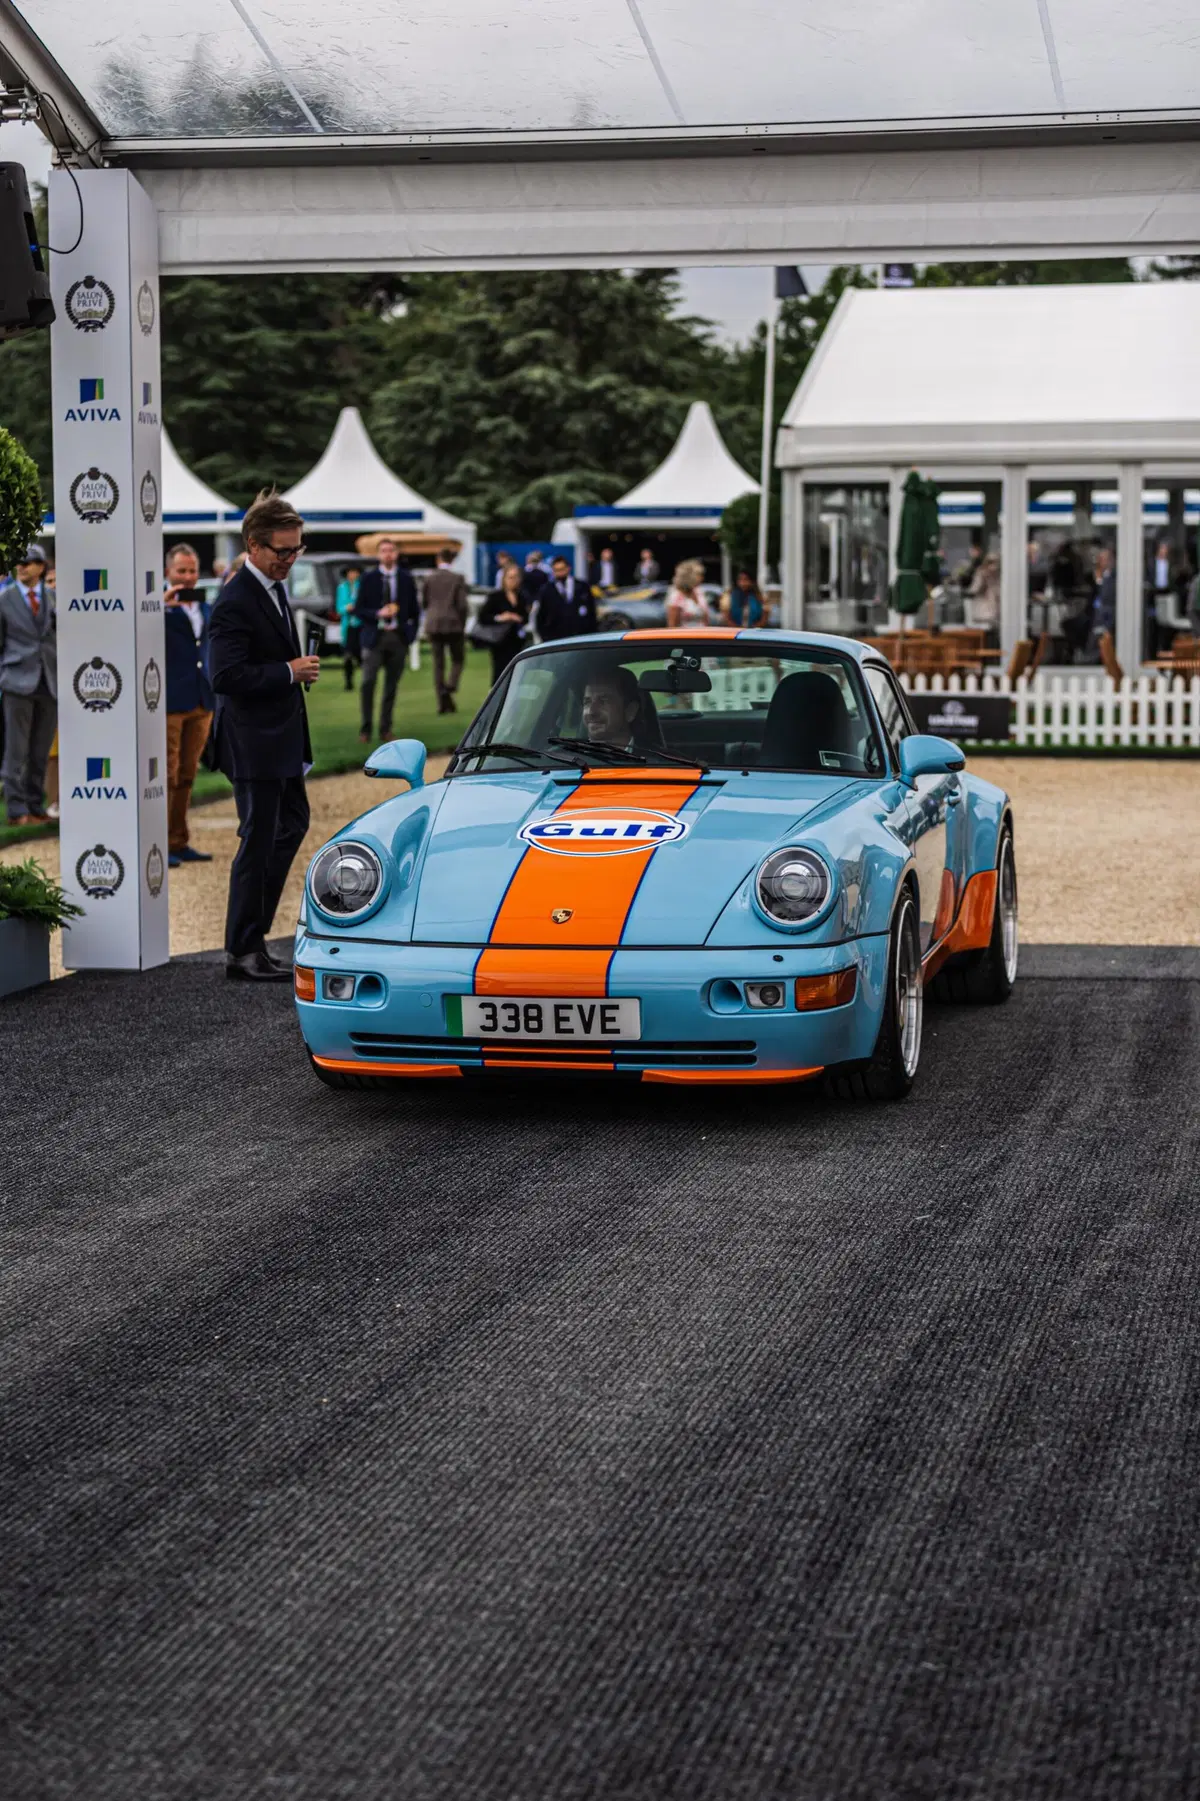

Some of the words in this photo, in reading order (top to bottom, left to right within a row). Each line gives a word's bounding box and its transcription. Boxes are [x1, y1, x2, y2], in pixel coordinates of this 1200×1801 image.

[64, 408, 121, 422] AVIVA
[138, 411, 158, 425] AVIVA
[81, 483, 107, 491] SALON
[68, 598, 124, 611] AVIVA
[140, 600, 161, 612] AVIVA
[71, 786, 127, 800] AVIVA
[143, 786, 164, 800] AVIVA
[529, 822, 676, 838] Gulf
[478, 1002, 544, 1034] 338
[553, 1004, 621, 1035] EVE
